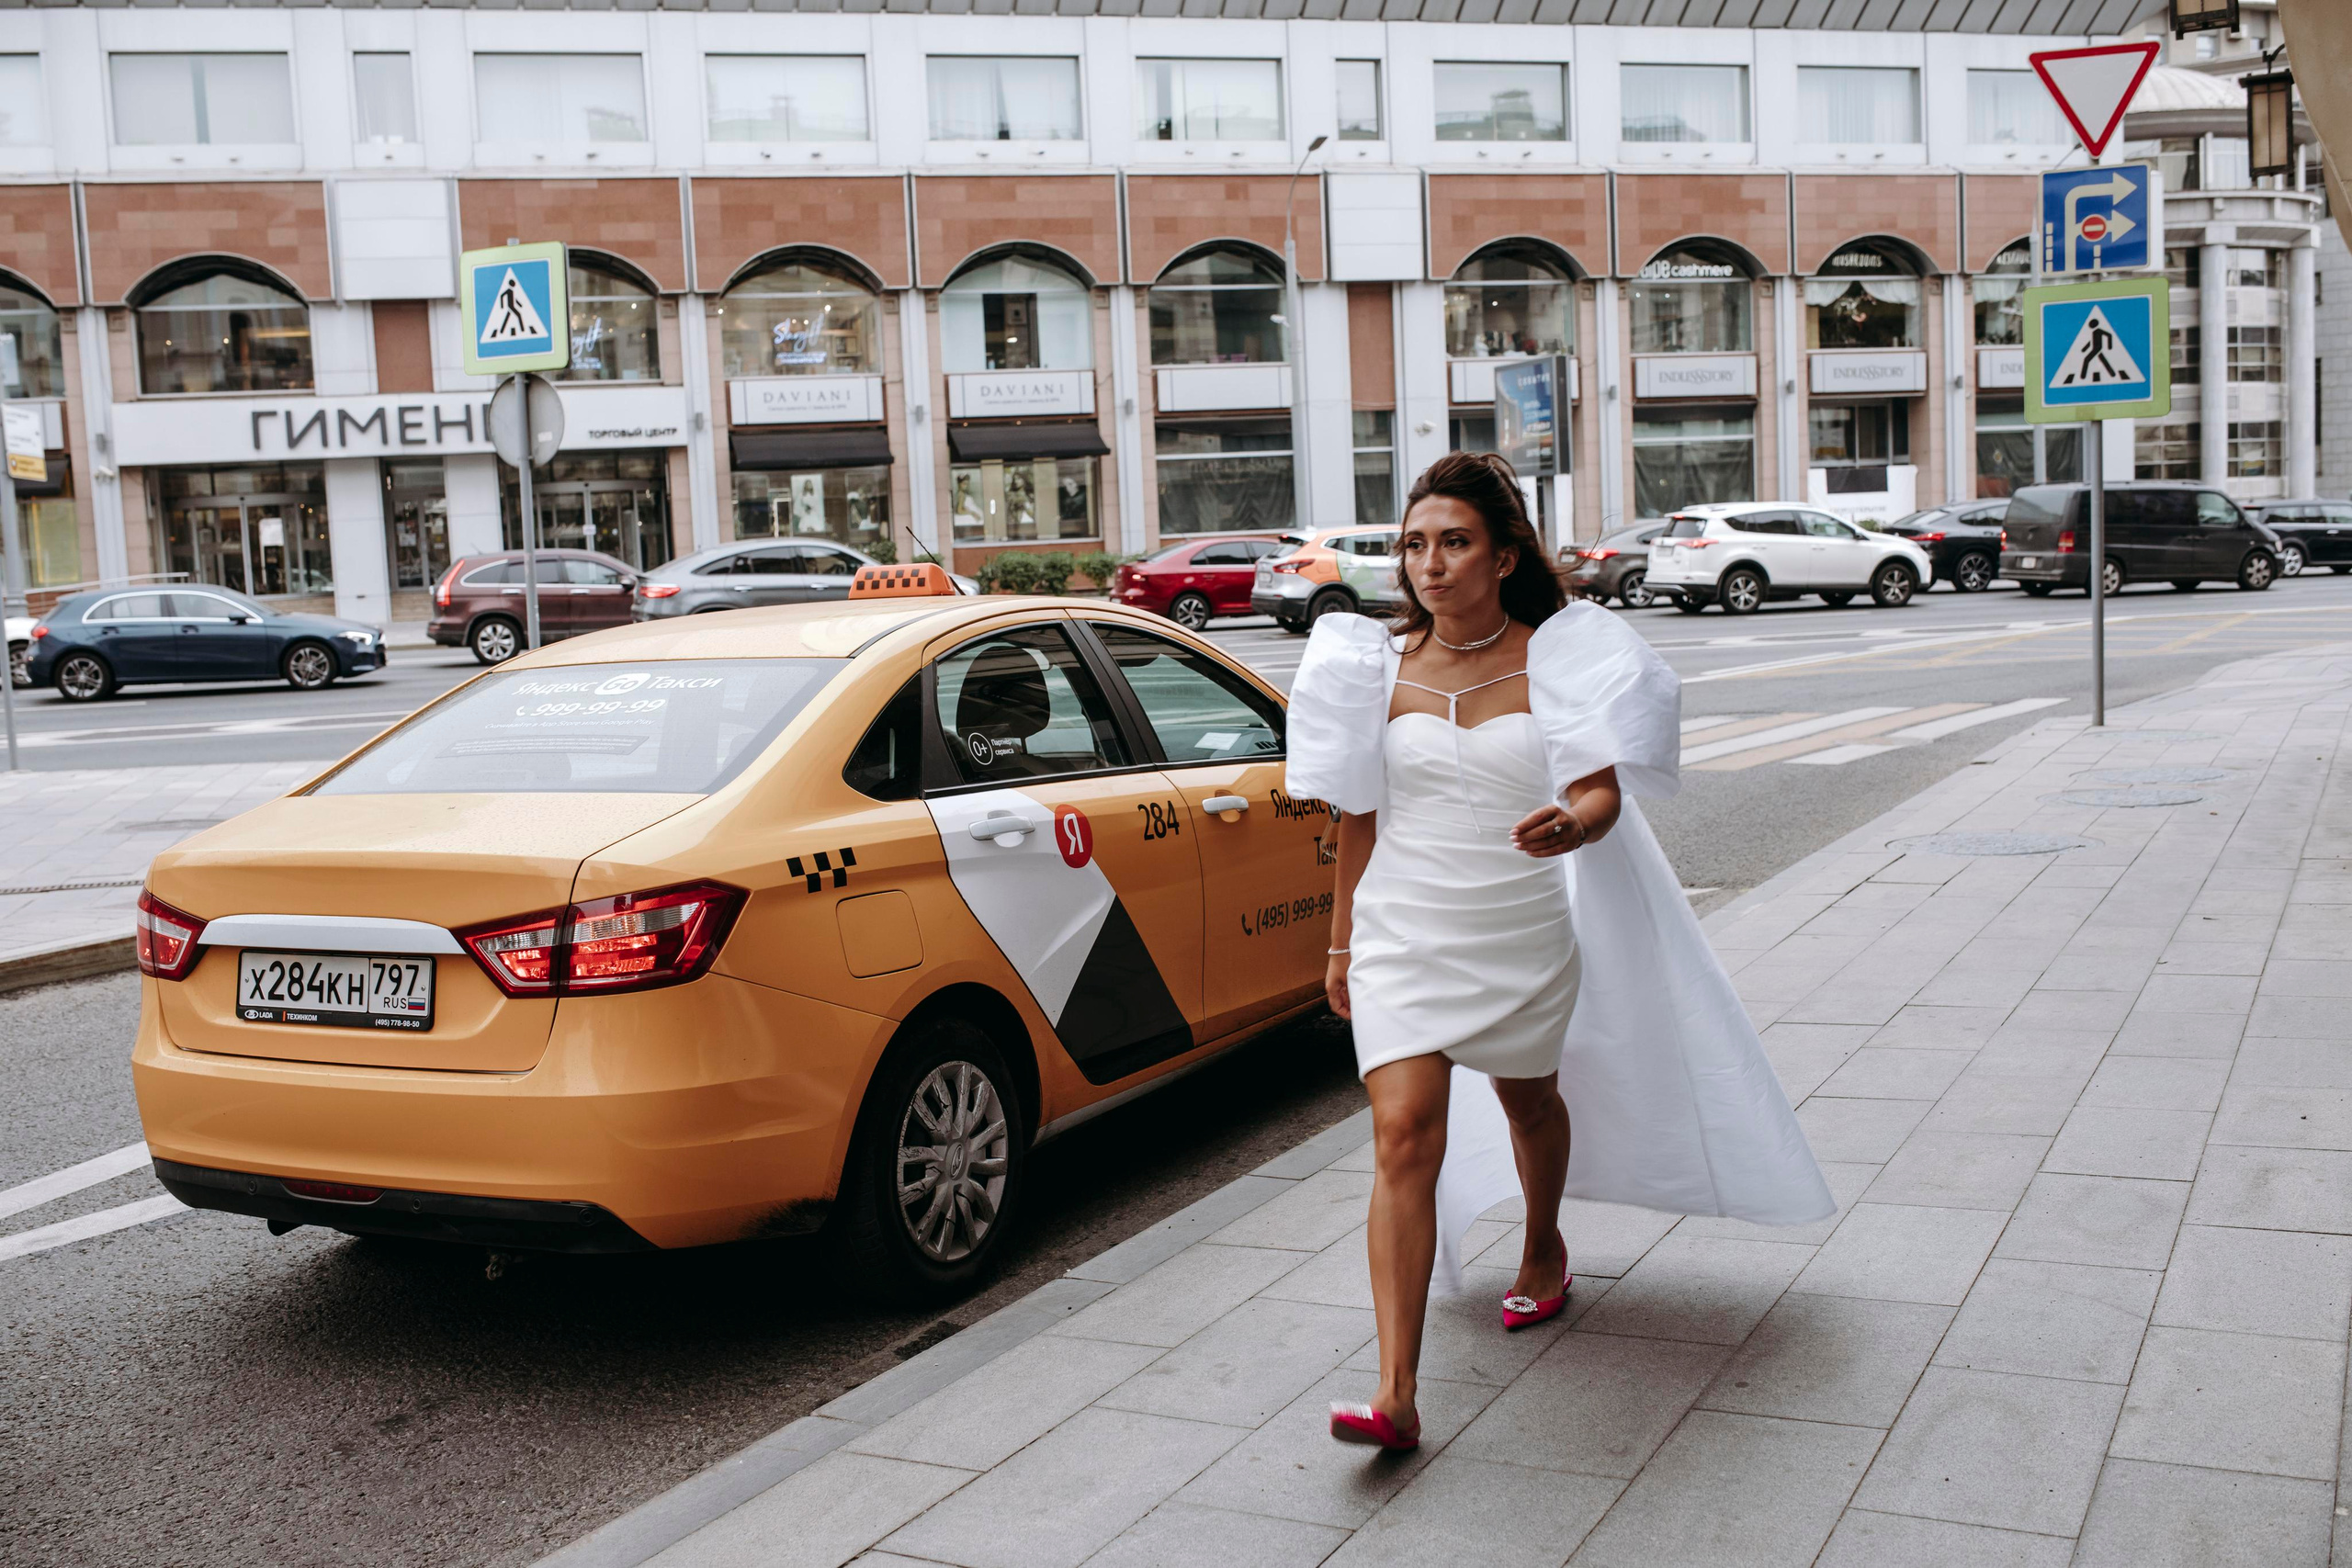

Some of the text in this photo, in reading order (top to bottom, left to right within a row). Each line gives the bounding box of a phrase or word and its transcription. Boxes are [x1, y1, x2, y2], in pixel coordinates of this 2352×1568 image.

[1670, 263, 1734, 276] cashmere
[763, 390, 851, 404] DAVIANI
[980, 384, 1064, 397] DAVIANI
[588, 427, 678, 439] ТОРГОВЫЙ ЦЕНТР
[512, 682, 598, 696] Яндекс
[646, 675, 724, 690] Такси
[530, 698, 666, 716] 999-99-99
[600, 718, 633, 727] Google
[994, 748, 1014, 756] сервиса
[1271, 788, 1326, 821] Яндекс
[1137, 800, 1180, 841] 284
[1063, 813, 1084, 855] Я
[1256, 891, 1335, 936] (495) 999-99
[372, 963, 420, 997] 797
[383, 997, 407, 1010] RUS
[259, 1010, 274, 1020] LADA
[287, 1012, 318, 1022] ТЕХИНКОМ
[375, 1018, 420, 1028] (495) 778-98-50
